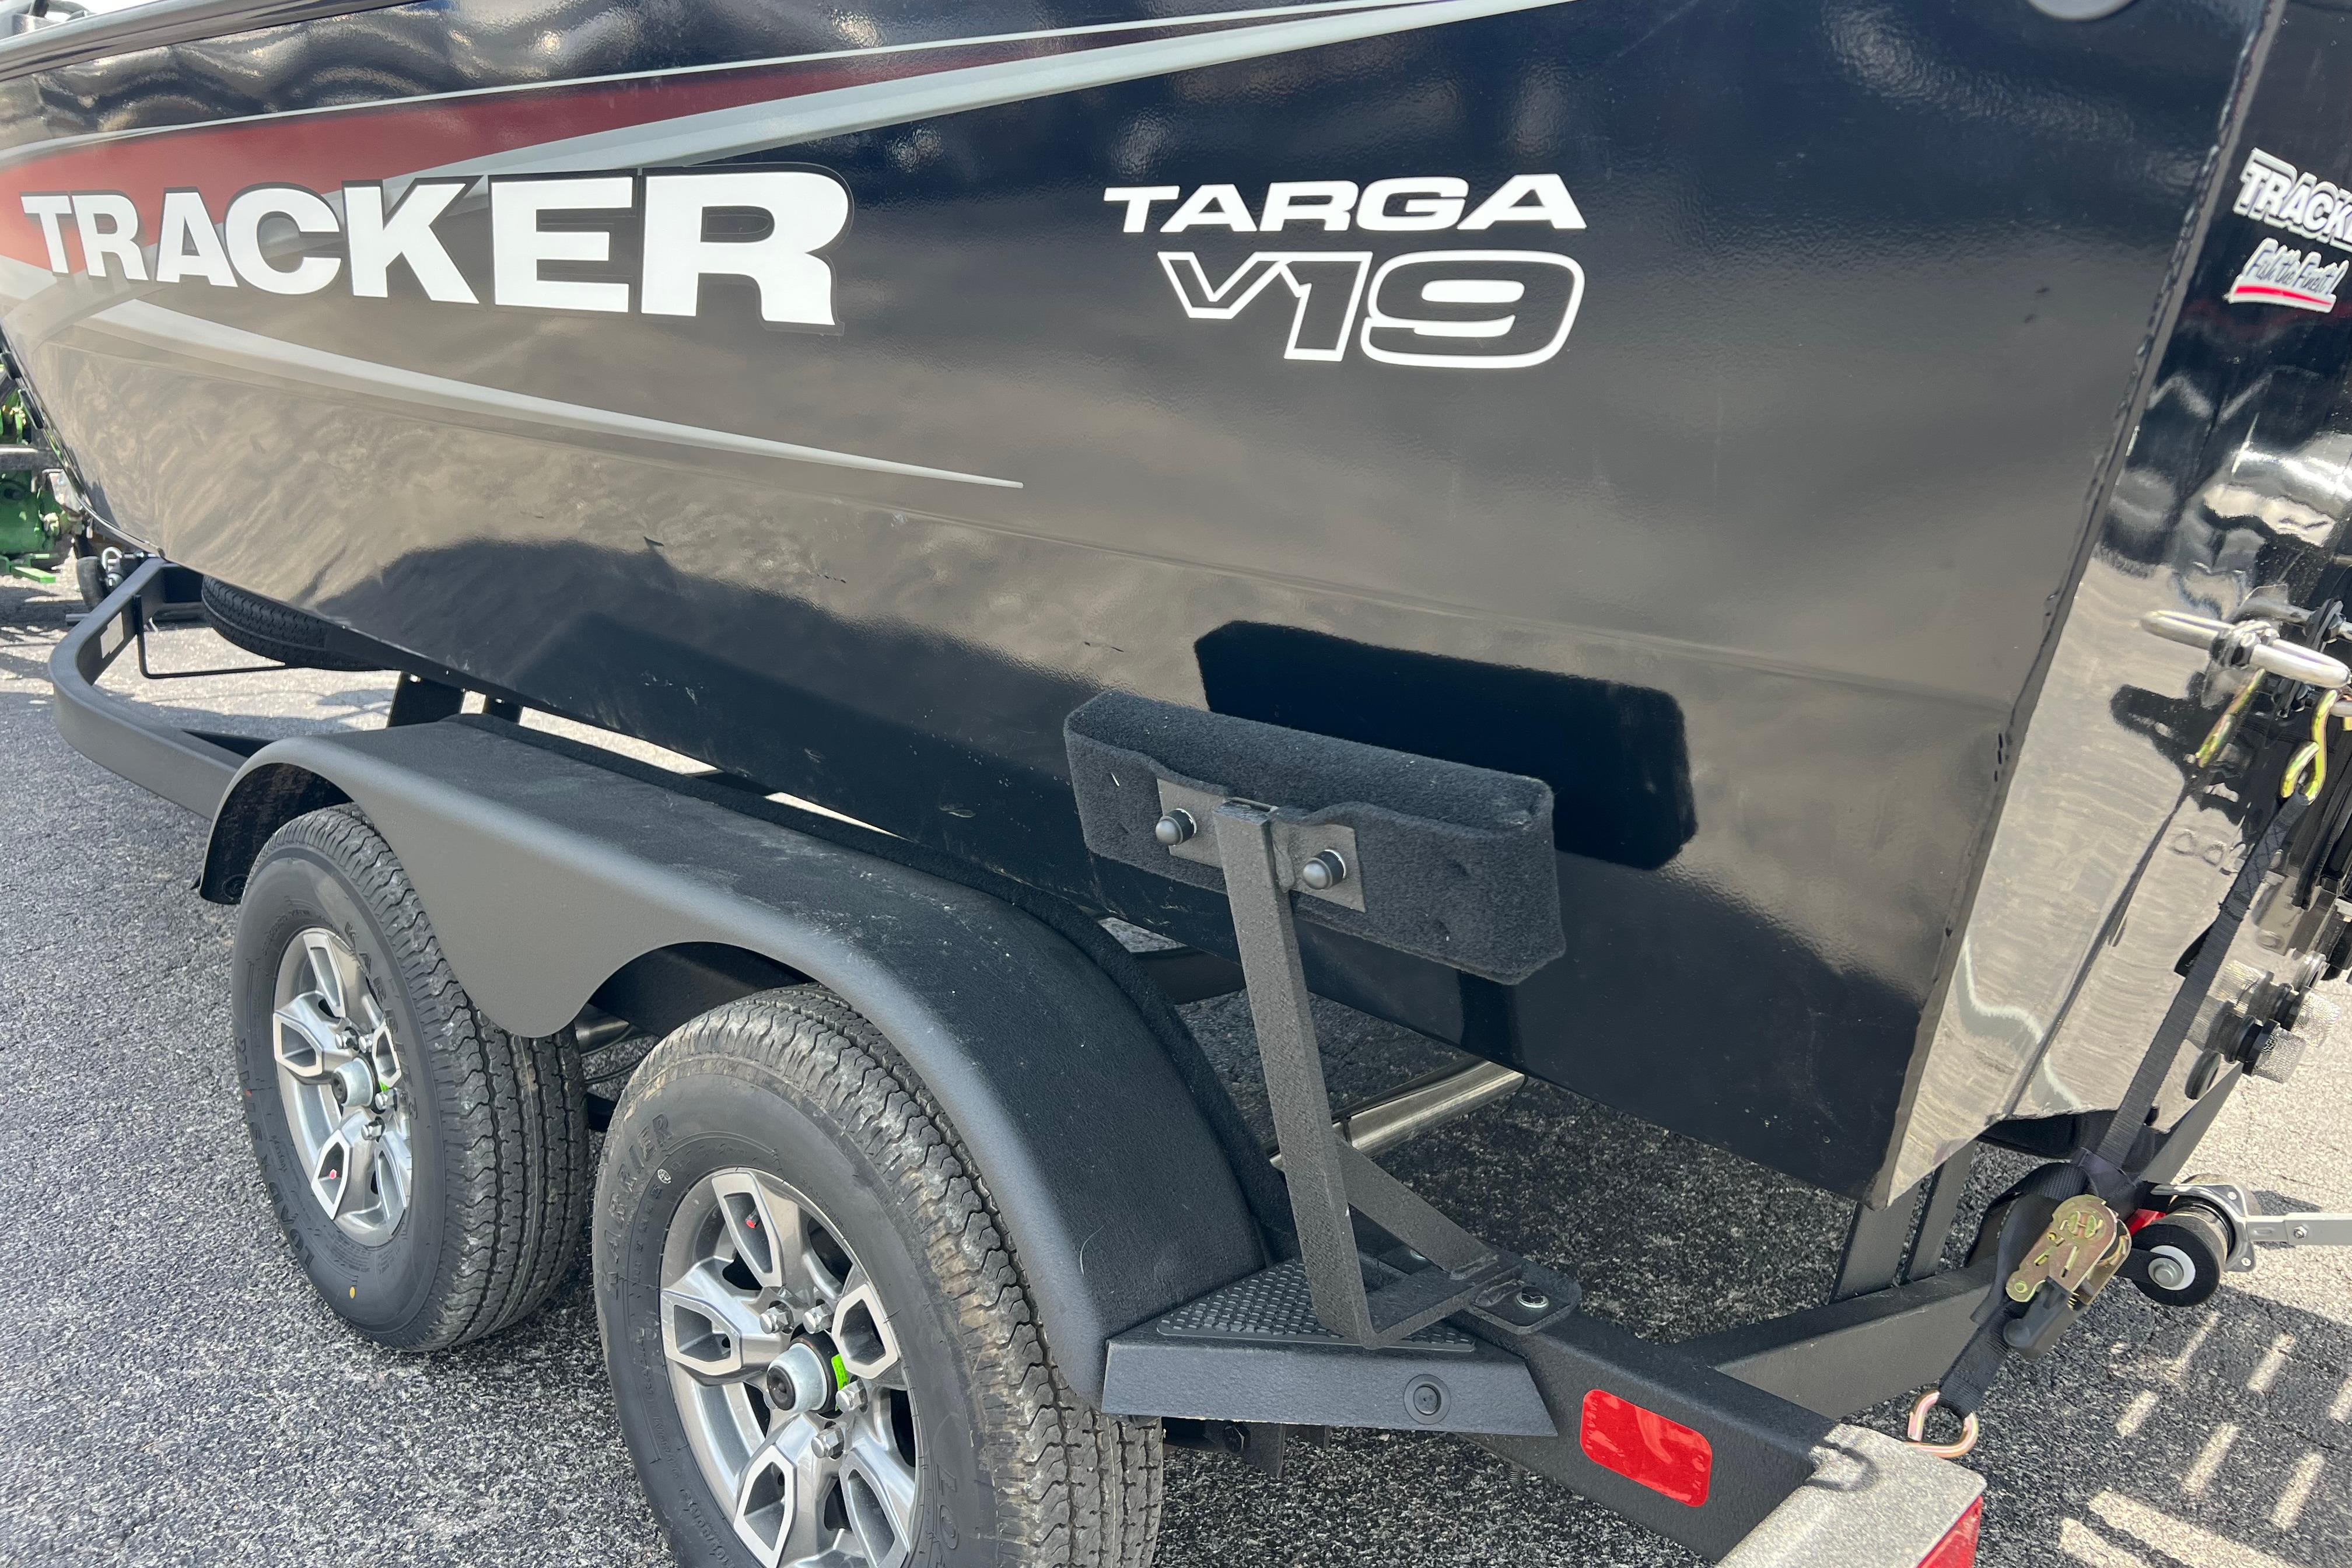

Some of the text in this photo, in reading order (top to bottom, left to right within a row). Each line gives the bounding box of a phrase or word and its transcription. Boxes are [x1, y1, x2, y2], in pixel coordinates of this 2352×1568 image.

[20, 170, 849, 327] TRACKER
[1103, 173, 1587, 233] TARGA
[1157, 250, 1586, 369] V19
